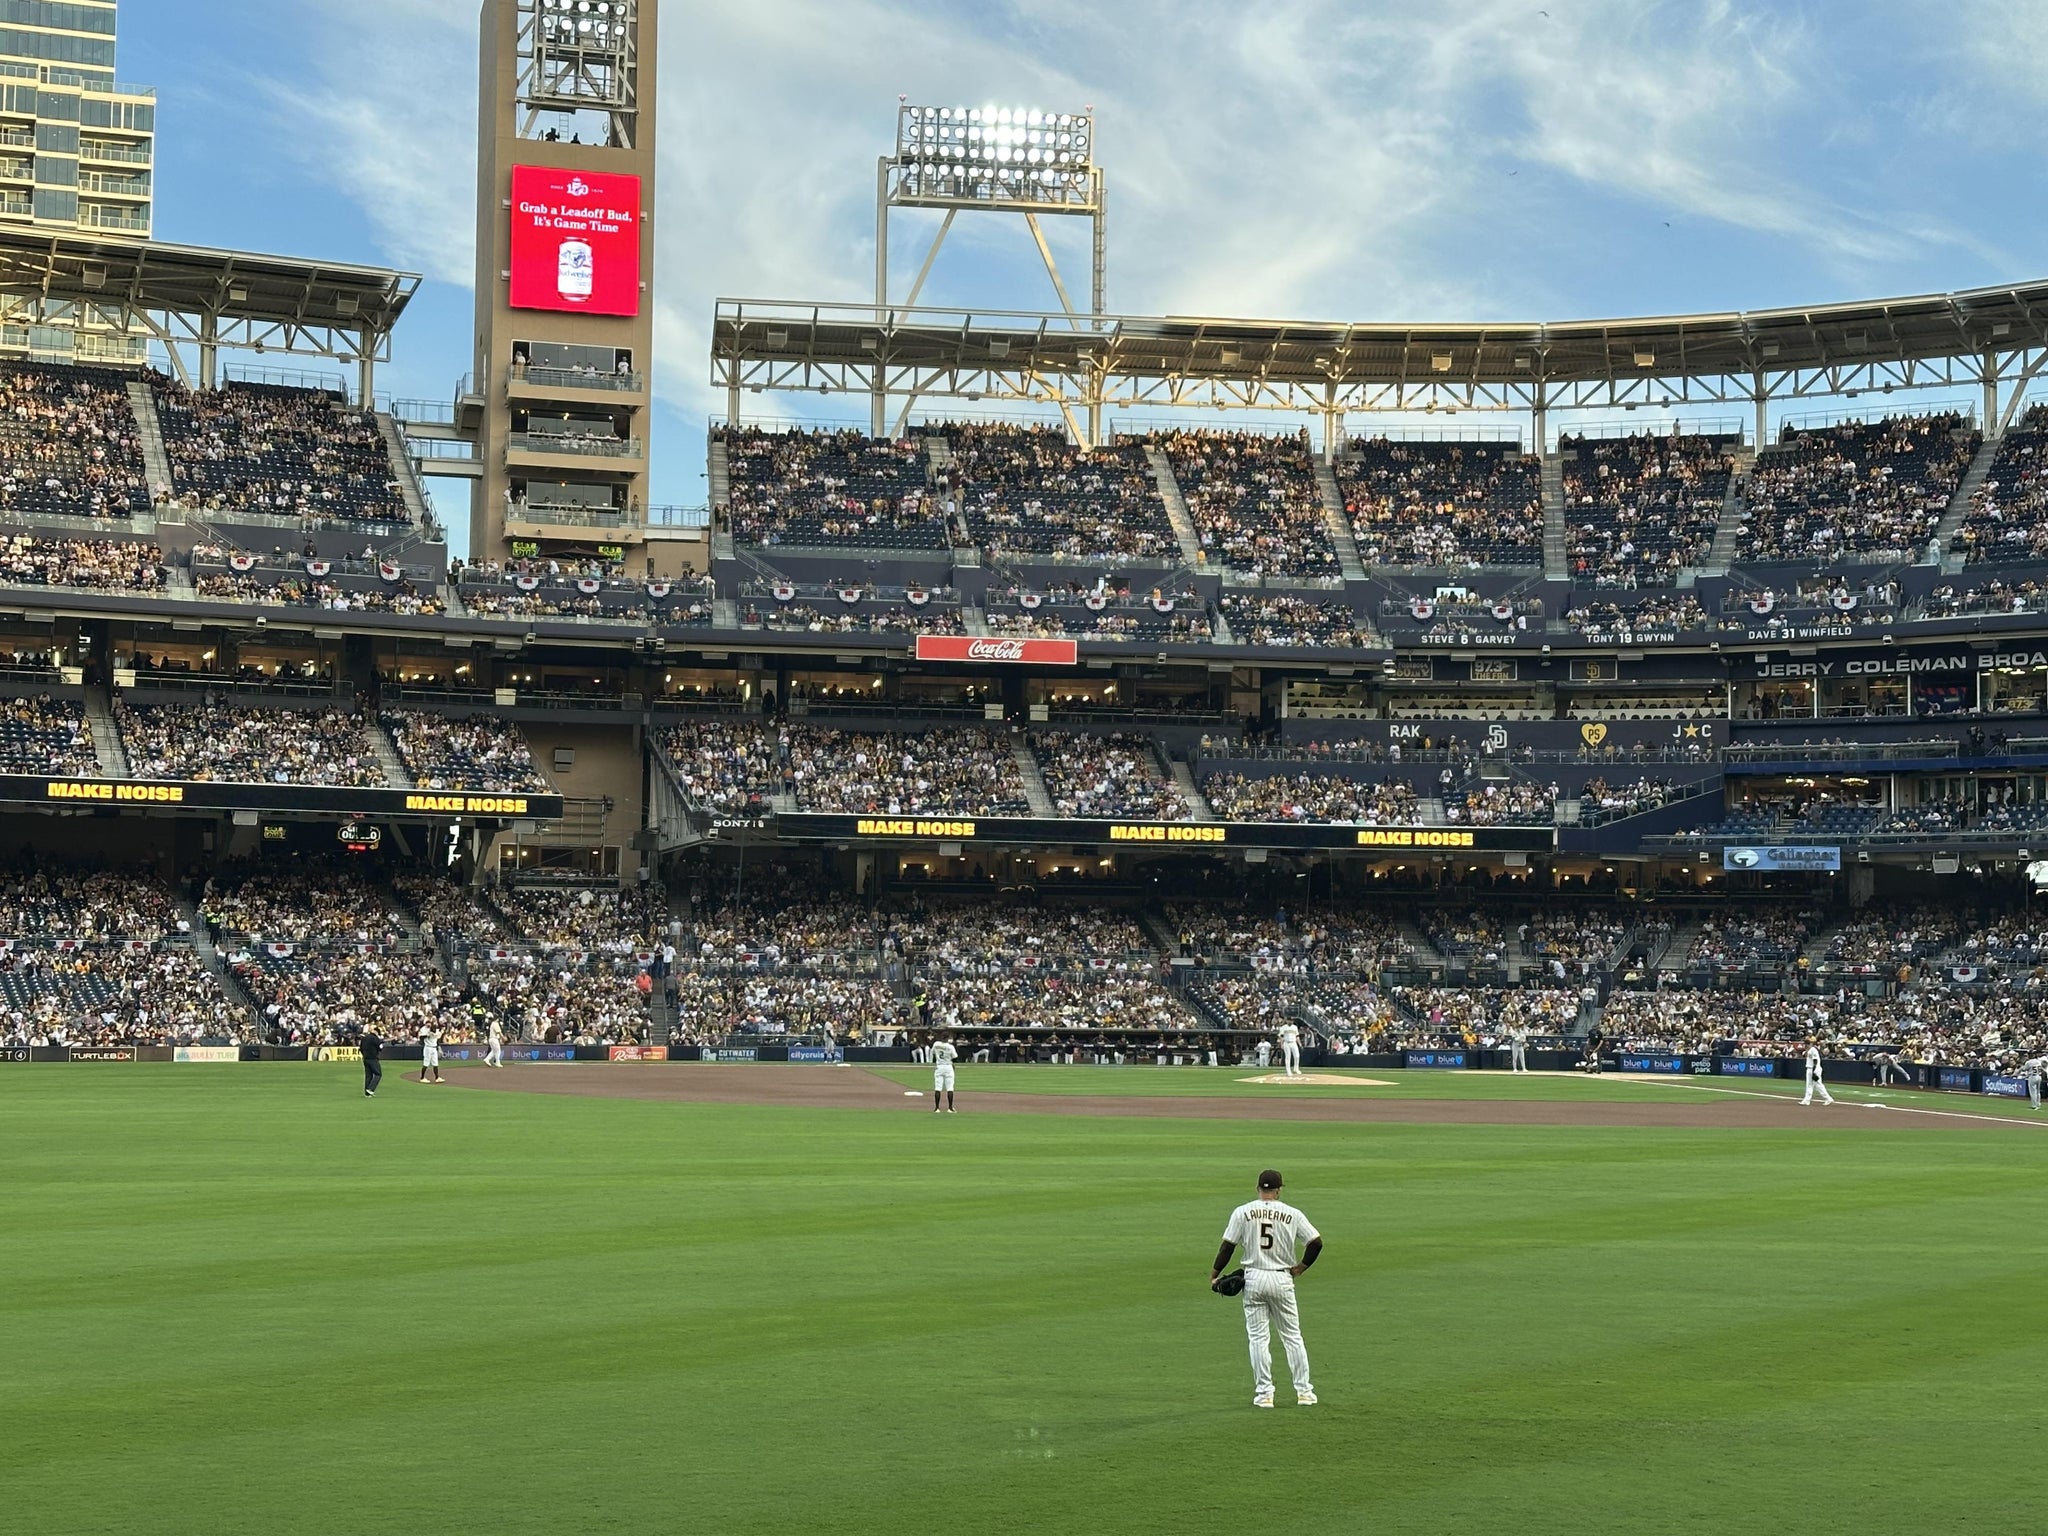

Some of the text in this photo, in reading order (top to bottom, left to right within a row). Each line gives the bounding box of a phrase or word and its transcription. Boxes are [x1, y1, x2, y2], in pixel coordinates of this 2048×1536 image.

[520, 201, 548, 214] Grab
[561, 205, 605, 219] Leadoff
[607, 210, 633, 222] Bud,
[533, 215, 619, 233] It's Game Time
[1421, 634, 1517, 645] STEVE 6 GARVEY
[1587, 633, 1675, 644] TONY 19 GWYNN
[1748, 626, 1852, 640] DAVE 31 WINFIELD
[1475, 660, 1503, 673] 97.3
[1757, 662, 1833, 678] JERRY
[1846, 655, 1967, 674] COLEMAN
[1389, 725, 1421, 738] RAK
[1588, 728, 1600, 740] PS
[1672, 724, 1712, 738] J C
[48, 782, 183, 801] MAKE NOISE
[406, 796, 527, 813] MAKE NOISE
[713, 819, 751, 828] SONY
[858, 820, 975, 836] MAKE NOISE
[1110, 826, 1225, 841] MAKE NOISE
[1358, 831, 1473, 846] MAKE NOISE
[1768, 848, 1836, 862] Gallagher
[71, 1052, 132, 1060] TURTLEBOX
[512, 1050, 532, 1059] blue
[548, 1050, 566, 1059] blue
[718, 1049, 756, 1057] CUTWATER
[1409, 1055, 1456, 1063] blue blue
[1623, 1059, 1642, 1067] blue
[1654, 1059, 1673, 1068] blue
[1722, 1062, 1766, 1071] blue blue
[1985, 1078, 2018, 1093] Southwest
[1243, 1208, 1293, 1225] LAUREANO
[1260, 1222, 1274, 1250] 5
